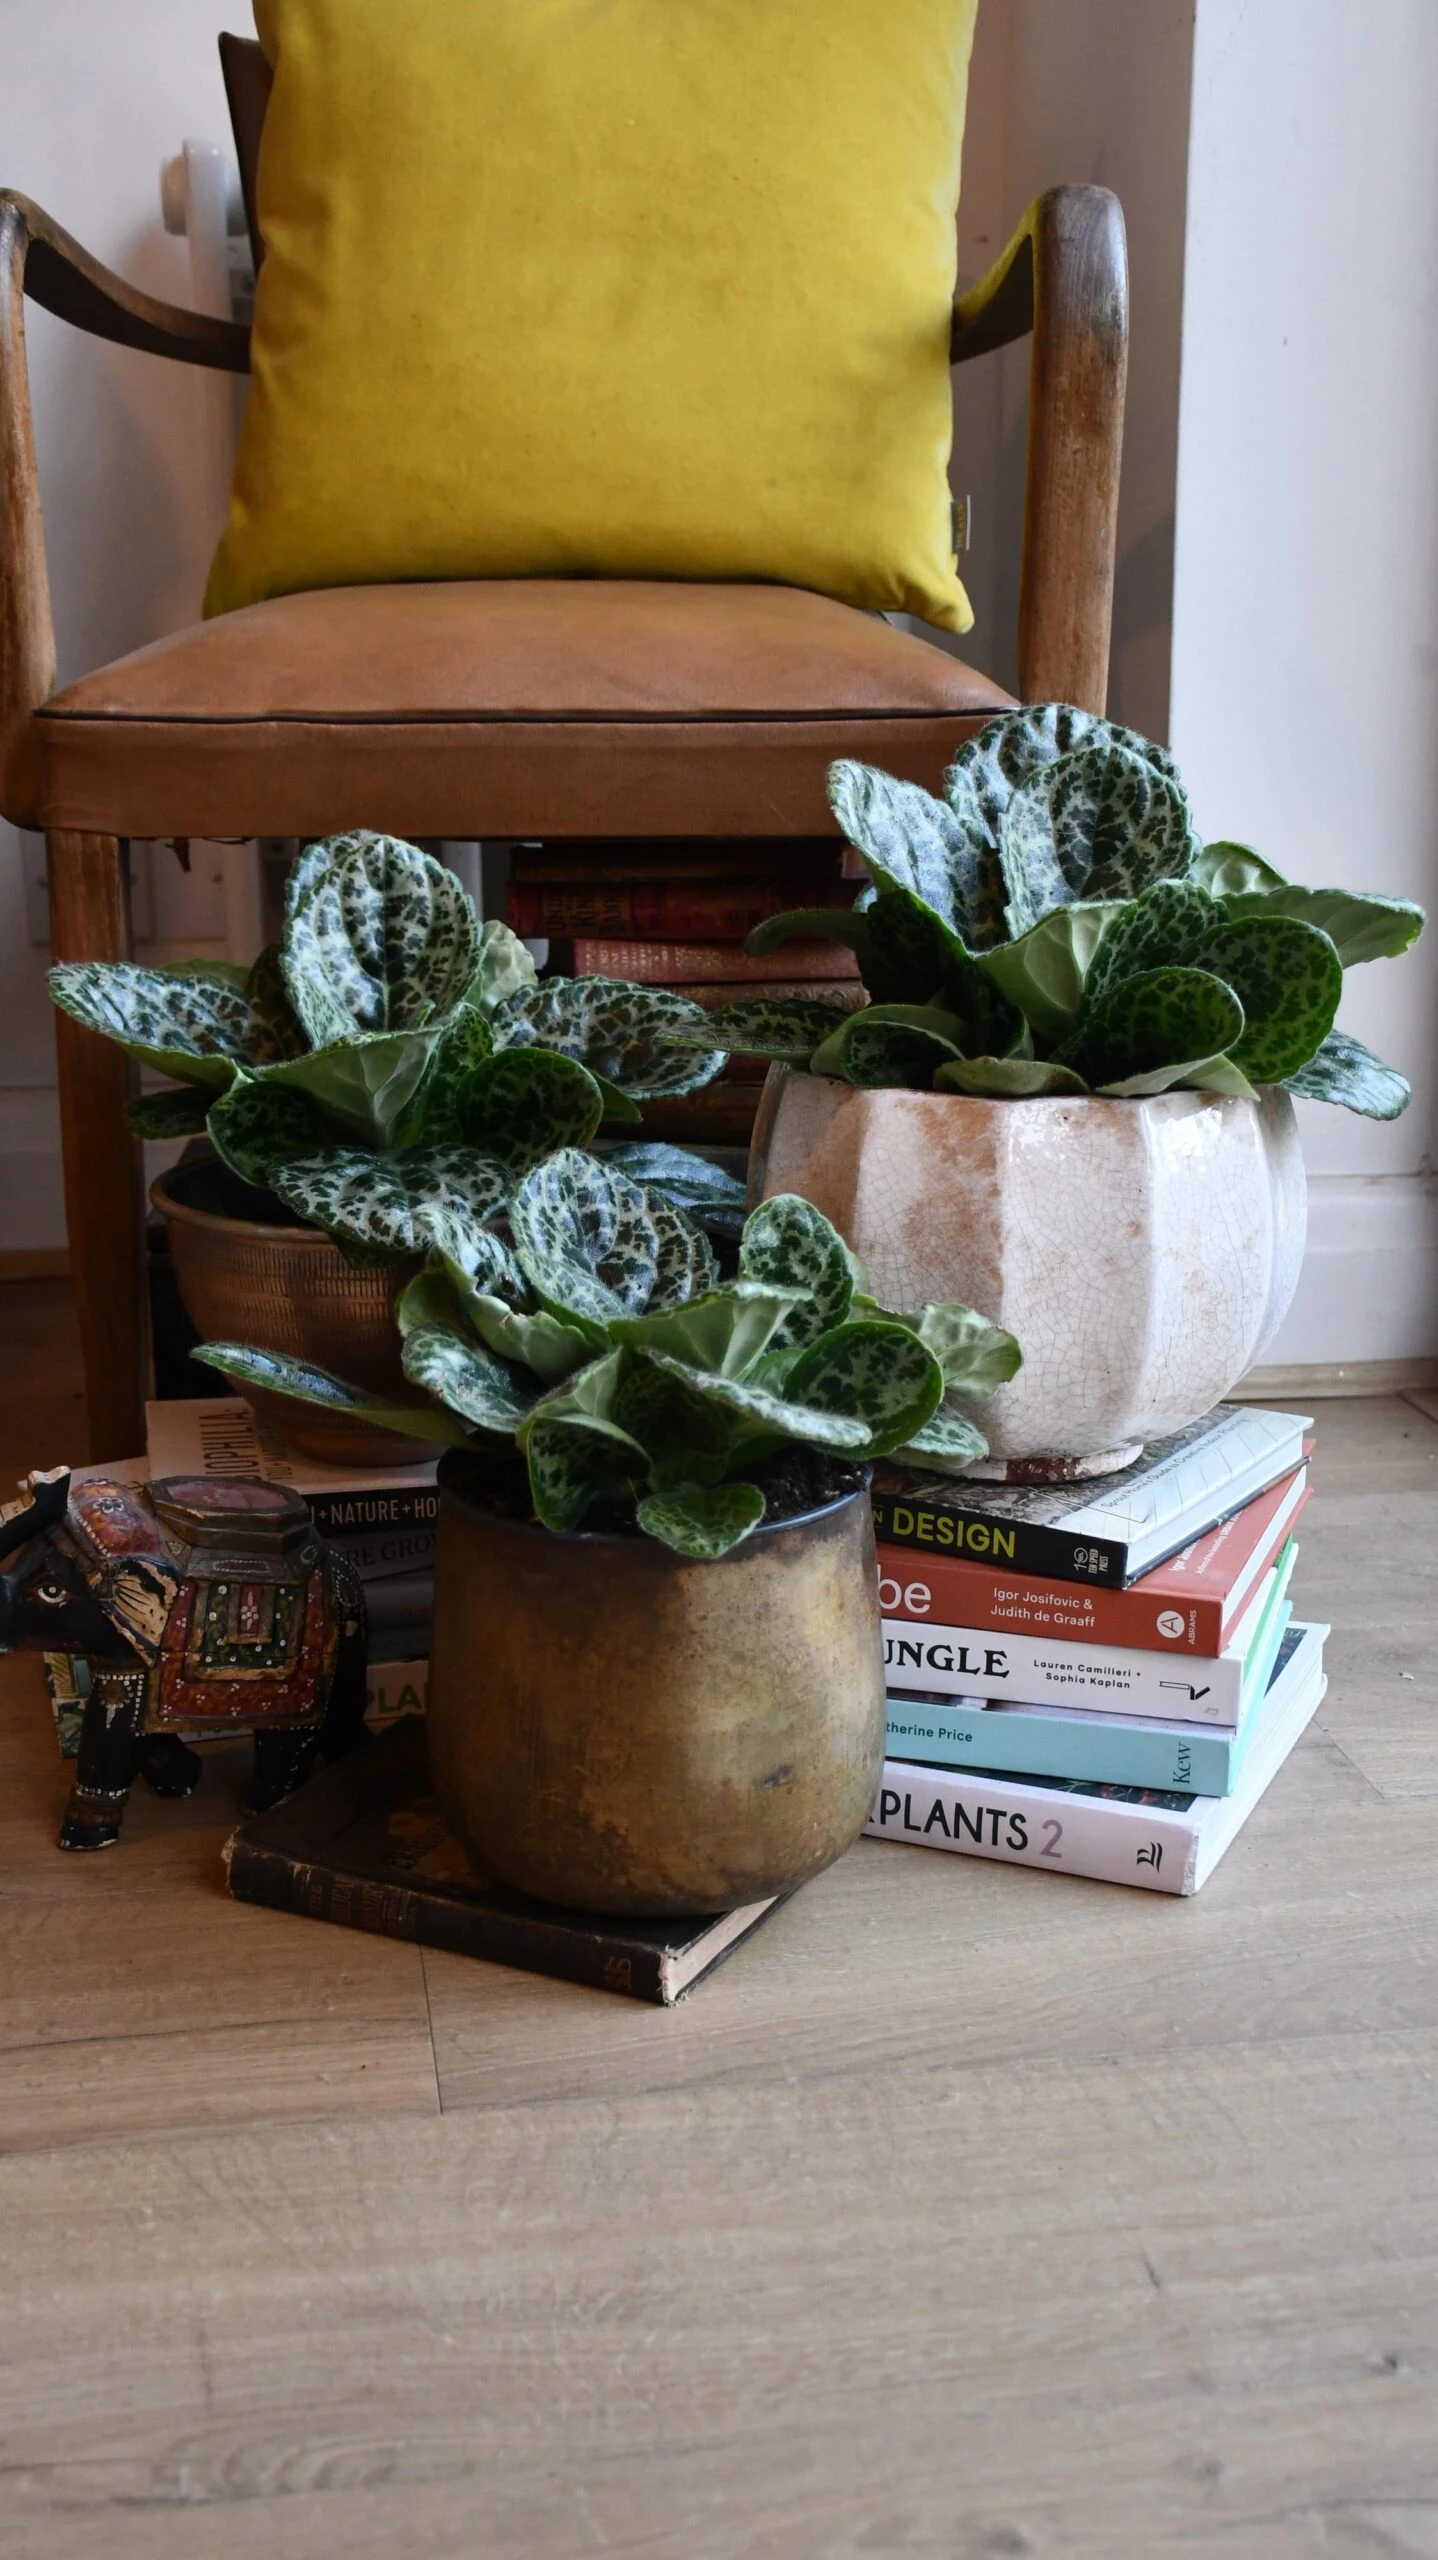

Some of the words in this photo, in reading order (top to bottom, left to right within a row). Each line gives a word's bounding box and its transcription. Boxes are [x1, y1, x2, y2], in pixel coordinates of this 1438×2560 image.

[199, 1408, 262, 1480] IOPHILIA:
[330, 1500, 399, 1524] NATURE
[414, 1497, 440, 1518] HO
[892, 1506, 1016, 1559] DESIGN
[381, 1532, 438, 1561] GRO
[1099, 1555, 1109, 1572] PRESS
[993, 1587, 1020, 1602] Igor
[1022, 1591, 1080, 1609] Josifovic
[1083, 1598, 1093, 1610] &
[990, 1604, 1031, 1620] Judith
[1034, 1609, 1051, 1622] de
[1053, 1612, 1096, 1628] Graaff
[1188, 1609, 1198, 1645] ABRAMS
[1033, 1659, 1074, 1671] Lauren
[1077, 1663, 1133, 1678] Camilleri
[1045, 1671, 1086, 1685] Sophia
[1089, 1676, 1131, 1690] Kaplan
[938, 1727, 974, 1743] Price
[1172, 1743, 1191, 1785] Kew
[869, 1789, 1029, 1851] PLANTS
[1040, 1819, 1064, 1859] 2
